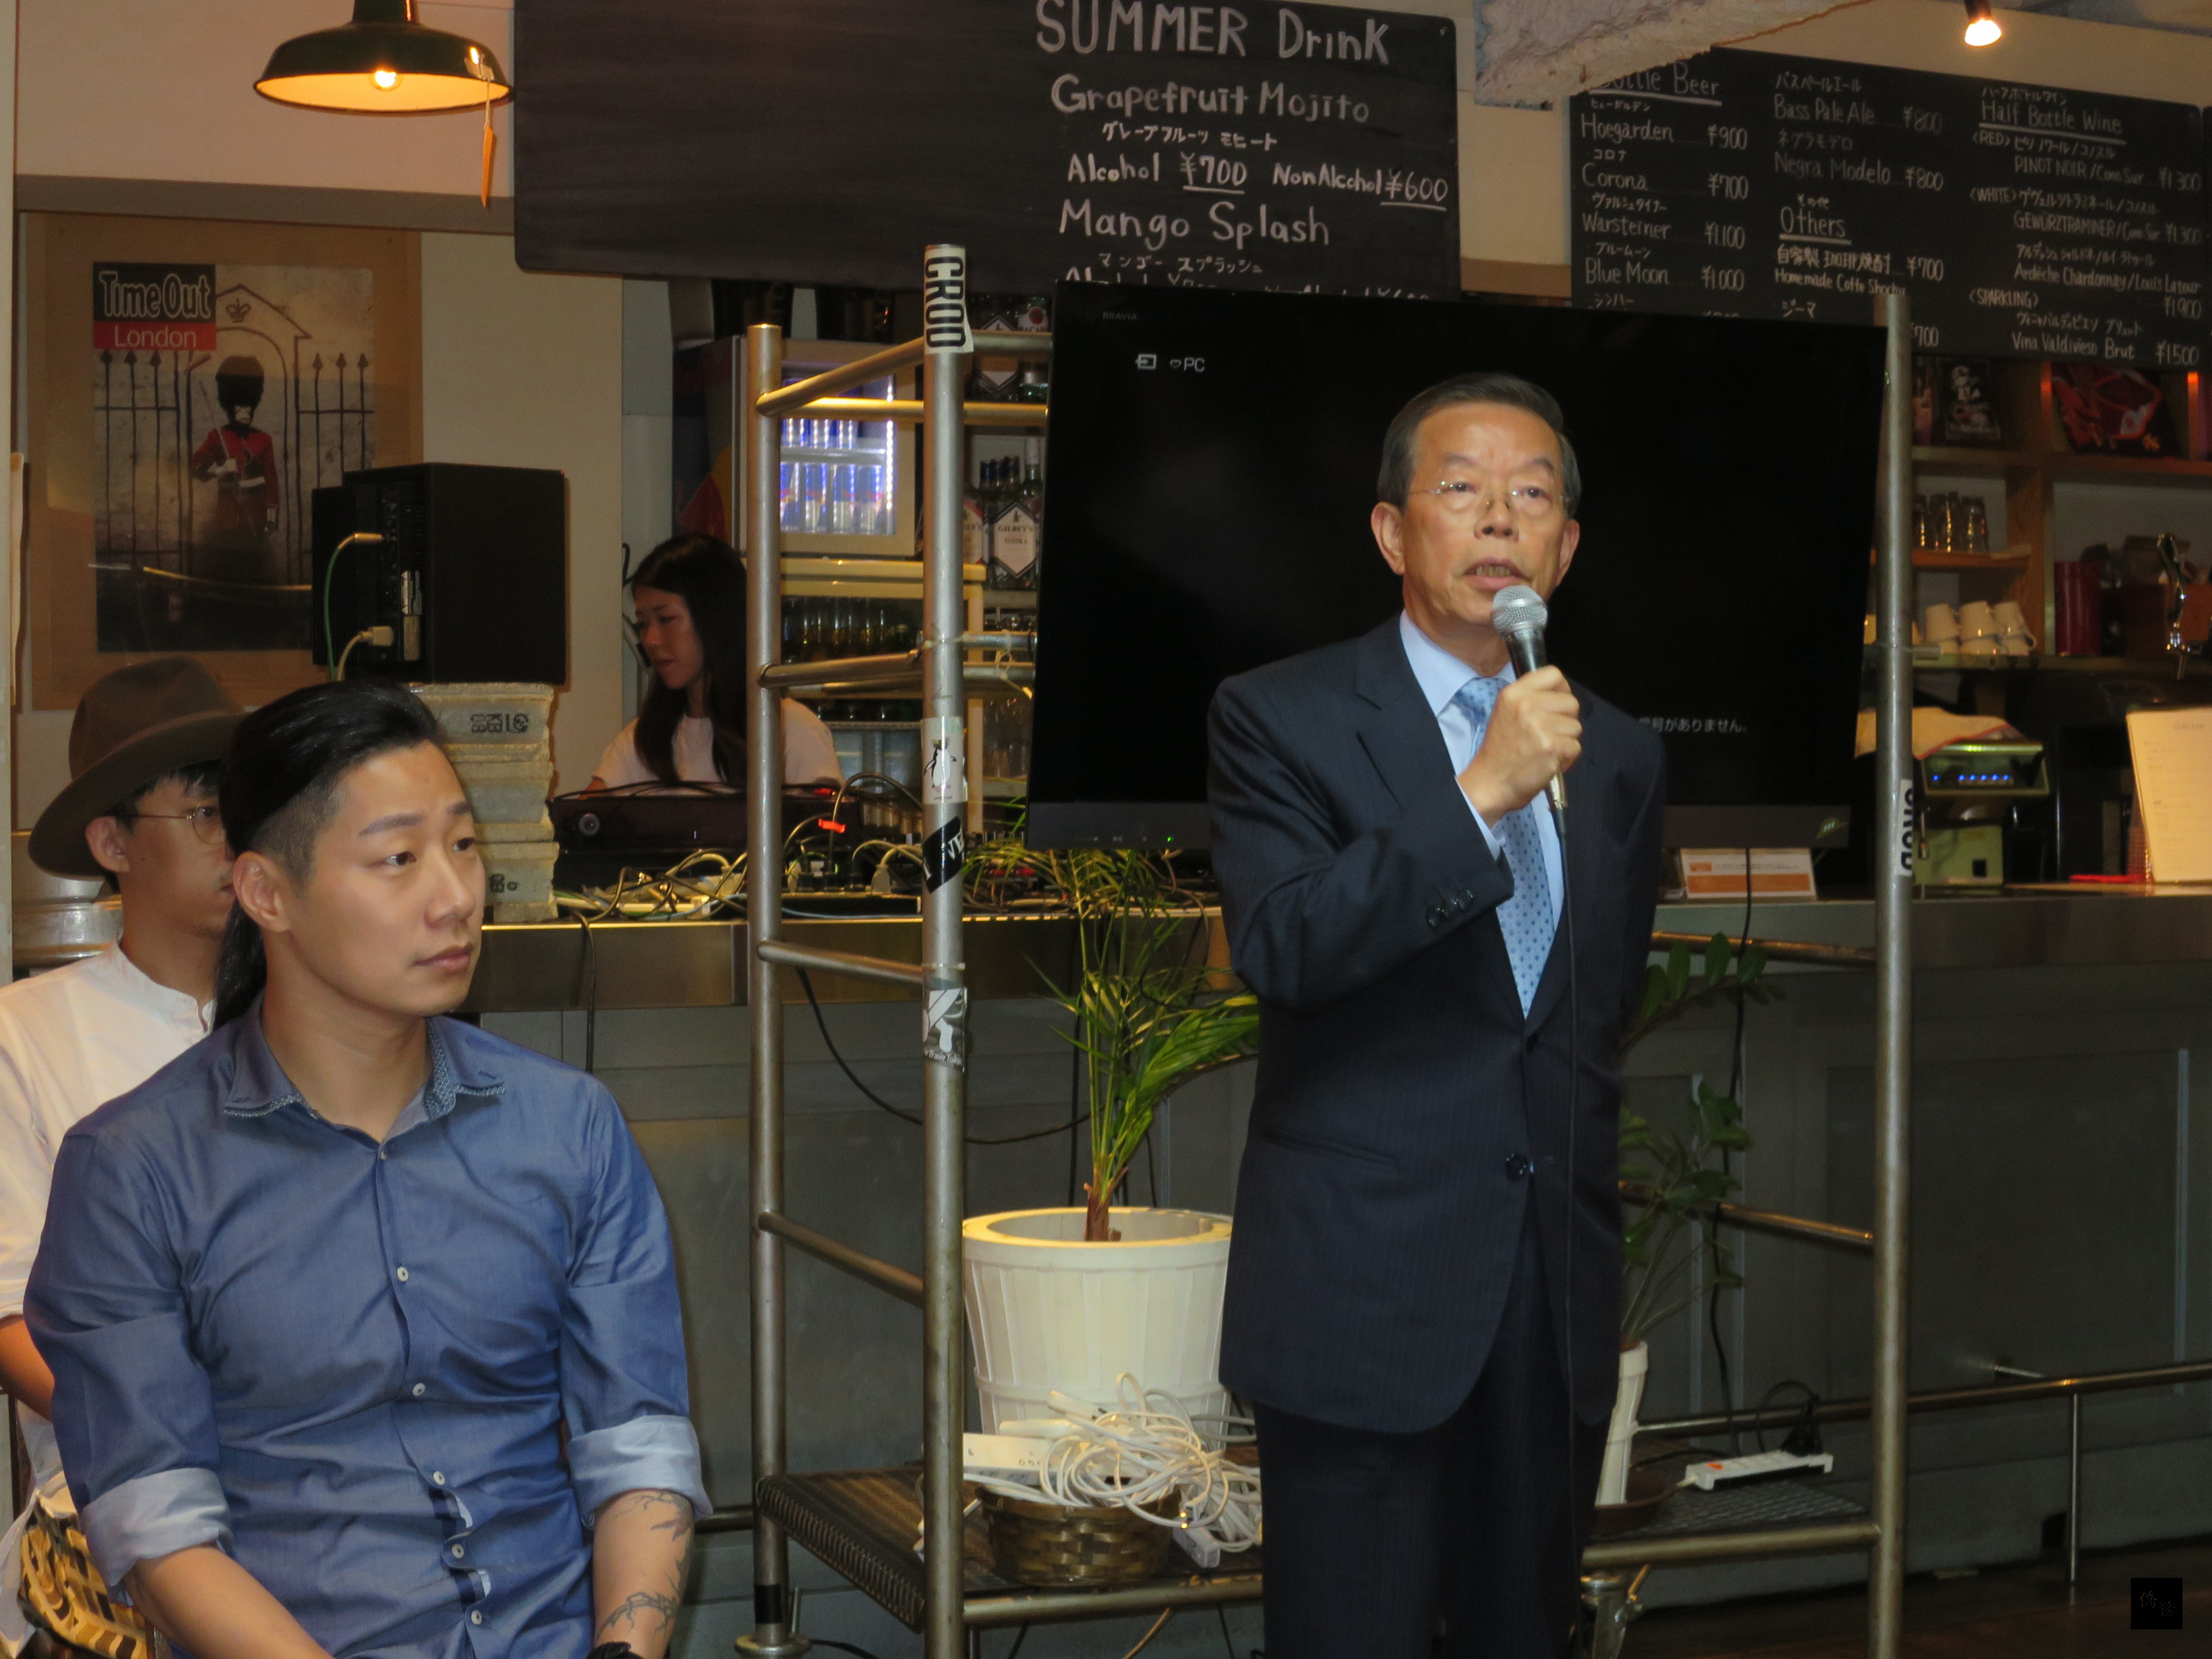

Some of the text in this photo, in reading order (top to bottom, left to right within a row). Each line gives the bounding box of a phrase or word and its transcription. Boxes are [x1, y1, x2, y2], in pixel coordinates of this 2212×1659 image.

[1037, 0, 1249, 57] SUMMER
[1599, 60, 1720, 95] ottle Beer
[1051, 74, 1369, 123] Grapefruit Mojito
[1774, 94, 1810, 120] Bass
[1815, 97, 1844, 123] Pale
[1846, 100, 1875, 125] Ale
[1982, 100, 2124, 135] Half Bottle Wine
[1102, 122, 1277, 150] グレープフルーツ モヒート
[1708, 125, 1747, 150] ¥900
[1067, 152, 1159, 183] Alcohol
[1180, 152, 1247, 187] ¥700
[1385, 170, 1448, 202] ¥600
[1582, 163, 1749, 200] Corona ¥700
[2014, 156, 2053, 174] PINOT
[2056, 159, 2087, 179] NOIR
[1059, 198, 1329, 251] Mango Splash
[1780, 206, 1846, 238] Others
[1099, 253, 1163, 271] マンゴー
[1585, 257, 1621, 285] Blue
[1626, 260, 1669, 285] Moon
[1907, 256, 1944, 282] ¥700
[114, 325, 197, 348] London
[1911, 321, 1939, 347] 700
[2105, 337, 2136, 361] Brut
[1184, 358, 1205, 372] PC
